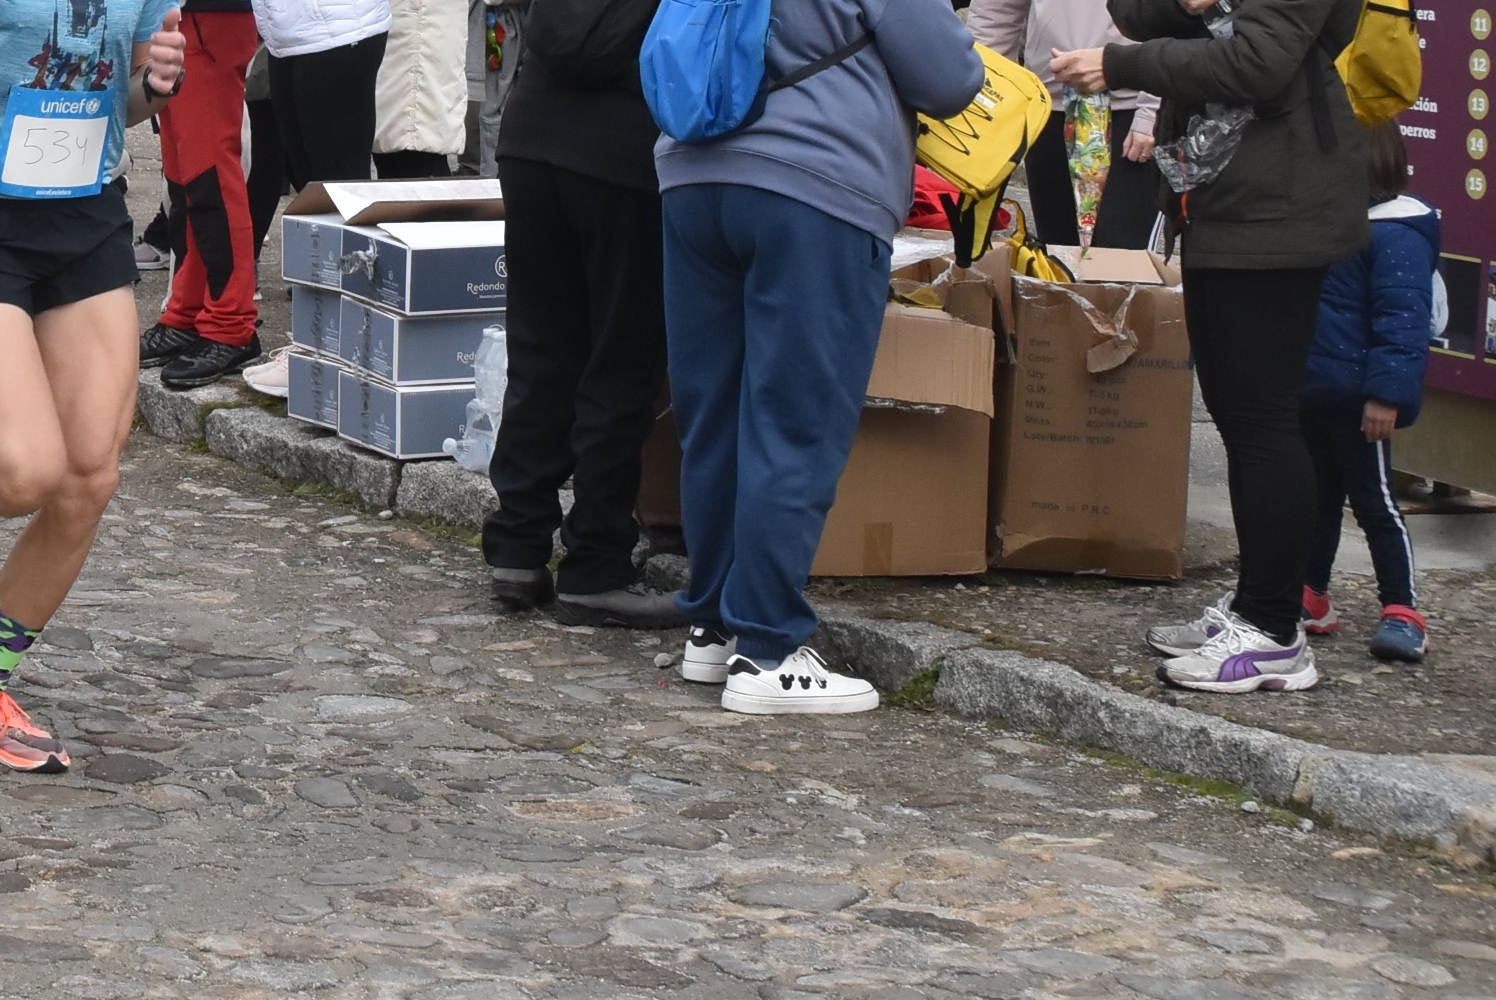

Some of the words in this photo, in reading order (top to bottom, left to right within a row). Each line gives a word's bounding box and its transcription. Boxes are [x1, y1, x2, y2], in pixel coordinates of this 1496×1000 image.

[1474, 18, 1488, 32] 11
[1473, 58, 1487, 72] 12
[41, 98, 86, 114] unicef
[1471, 98, 1485, 112] 13
[23, 127, 89, 166] 534
[1470, 137, 1484, 152] 14
[1469, 177, 1483, 191] 15
[467, 282, 505, 295] Redondo
